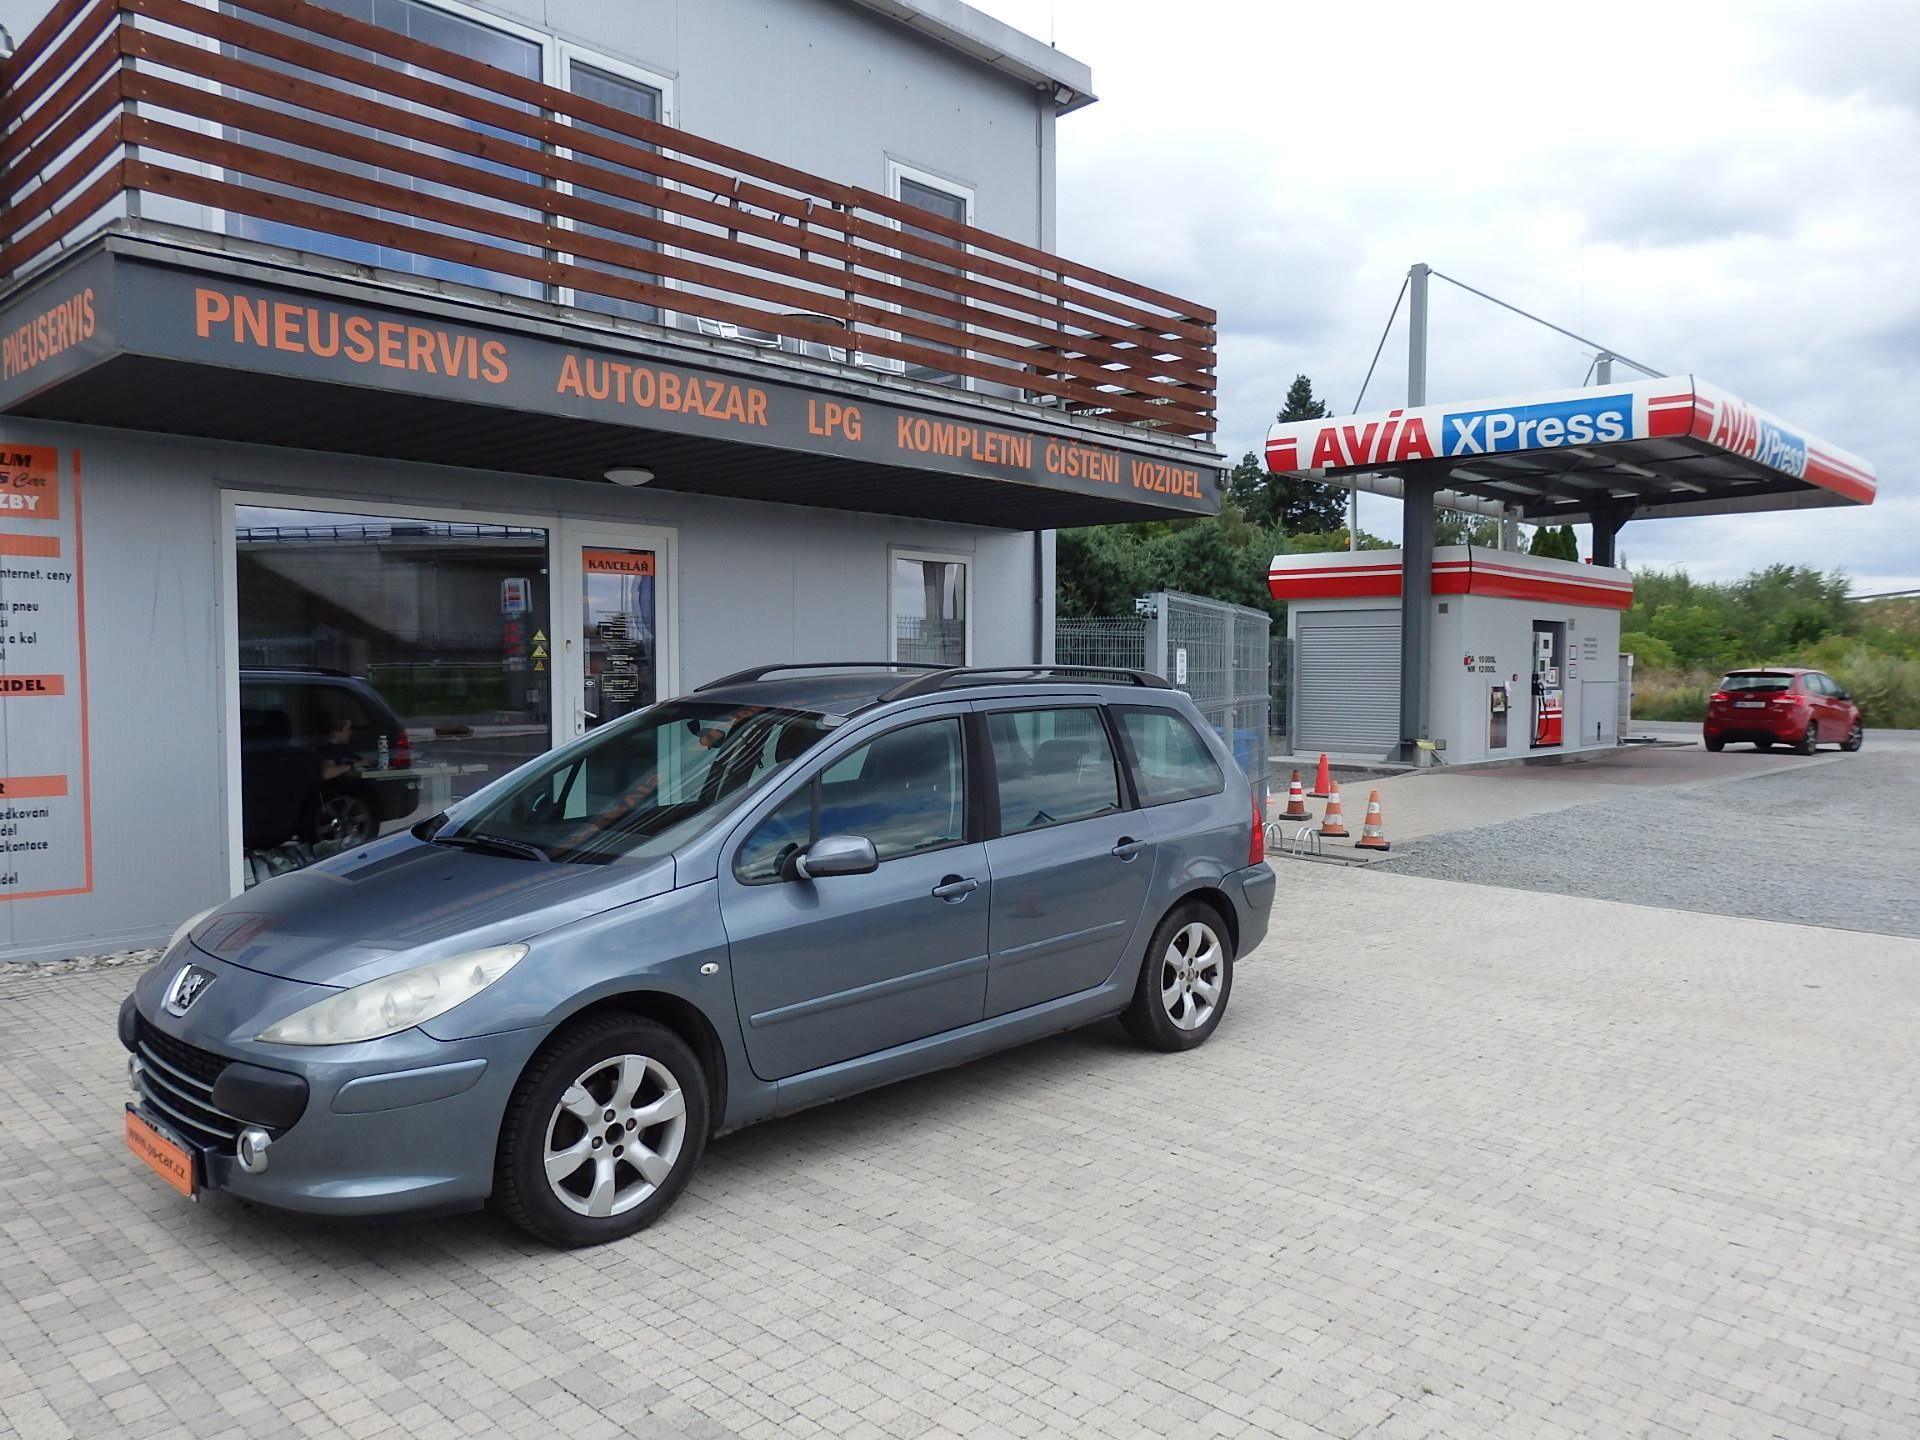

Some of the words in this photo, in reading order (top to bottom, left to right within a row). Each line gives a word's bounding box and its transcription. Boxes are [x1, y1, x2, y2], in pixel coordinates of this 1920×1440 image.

[3, 287, 95, 382] PNEUSERVIS
[195, 287, 509, 384] PNEUSERVIS
[556, 354, 768, 427] AUTOBAZAR
[808, 399, 862, 440] LPG
[896, 415, 1034, 469] KOMPLETNÍ
[1131, 459, 1203, 499] VOZIDEL
[1450, 410, 1625, 457] XPress
[1757, 424, 1805, 479] XPress
[47, 571, 72, 584] ceny
[587, 559, 649, 572] KANCELÁŘ
[12, 603, 39, 614] pneu
[20, 631, 37, 644] kol
